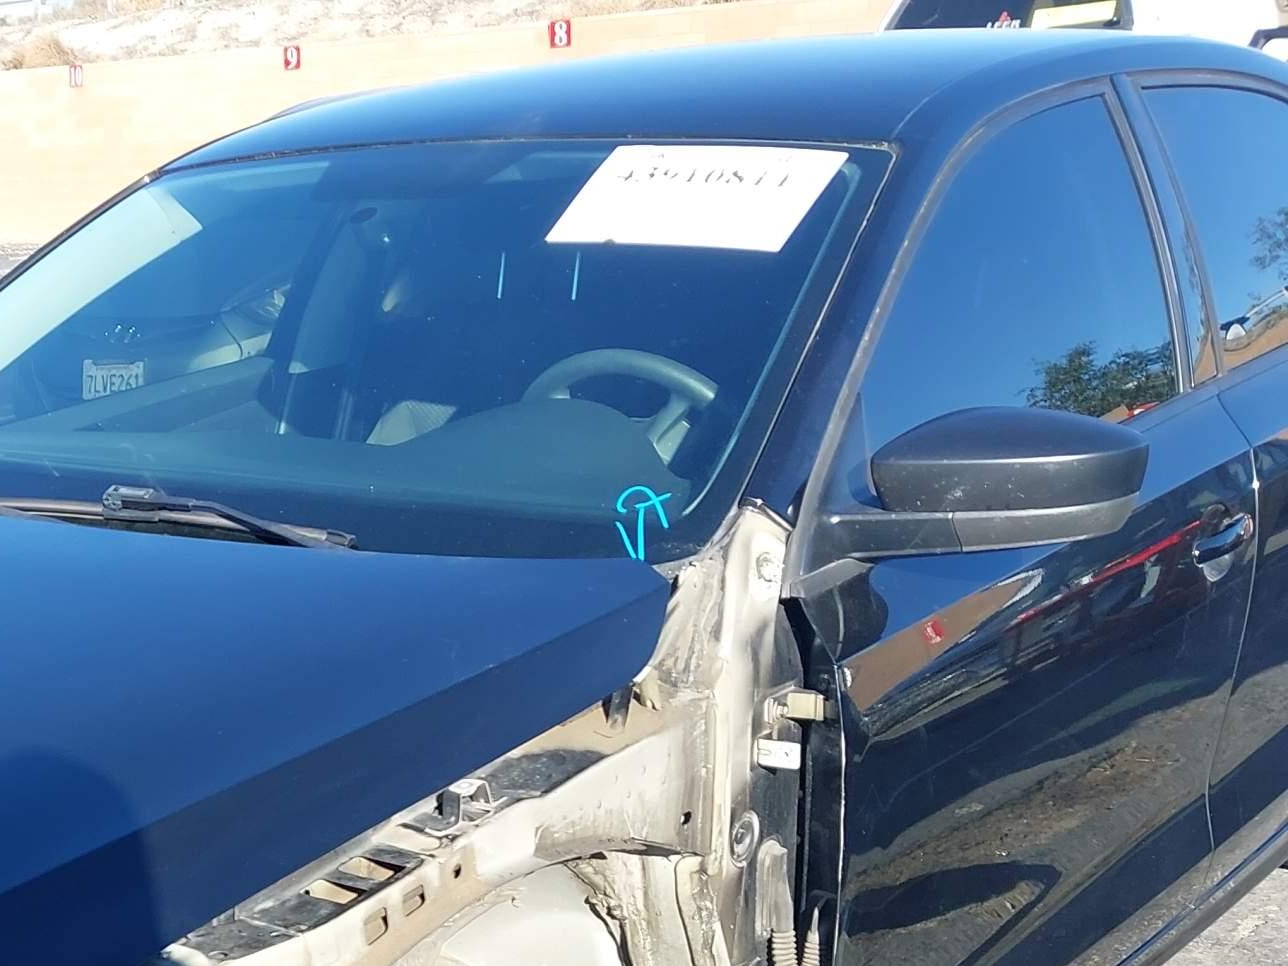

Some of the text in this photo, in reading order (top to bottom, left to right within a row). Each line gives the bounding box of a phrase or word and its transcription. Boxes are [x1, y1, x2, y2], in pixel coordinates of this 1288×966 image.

[553, 20, 568, 46] 8
[286, 47, 299, 70] 9
[69, 65, 83, 88] 10
